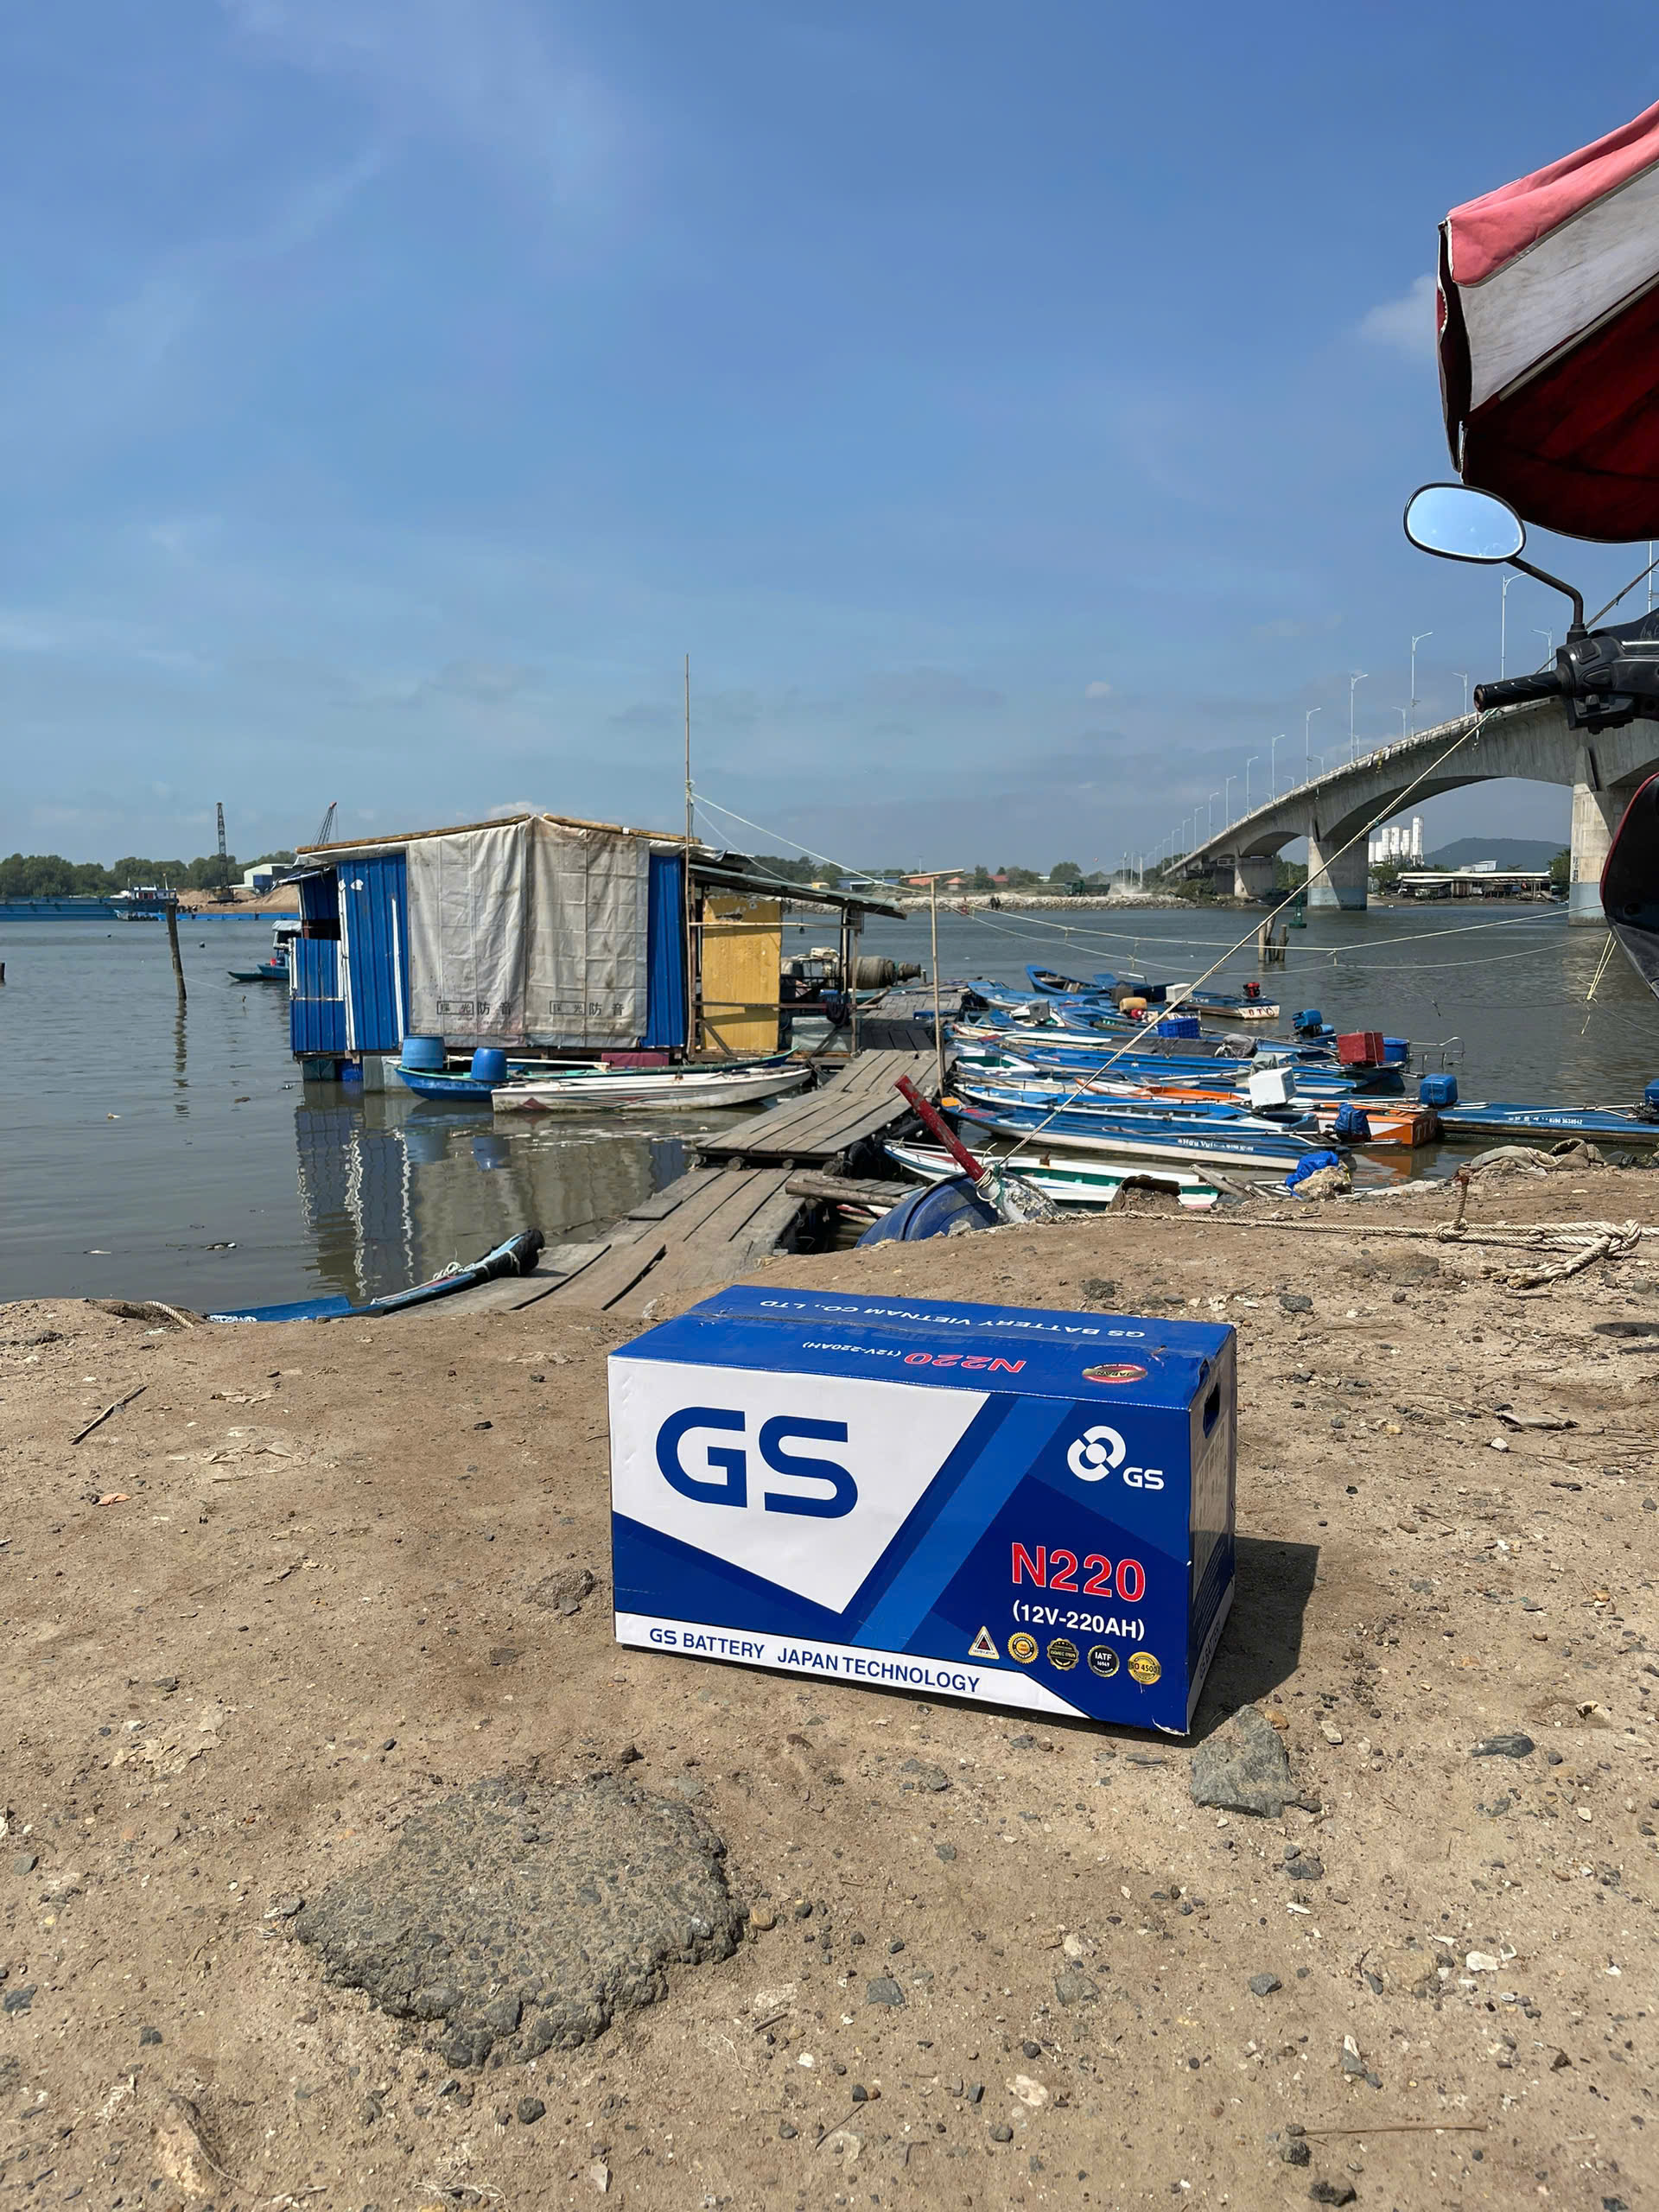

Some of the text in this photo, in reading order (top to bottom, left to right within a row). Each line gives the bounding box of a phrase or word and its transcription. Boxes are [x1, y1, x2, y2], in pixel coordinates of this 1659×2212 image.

[477, 1002, 512, 1016] 防音
[588, 1002, 625, 1016] 防音
[760, 1300, 807, 1309] LTD
[864, 1308, 970, 1325] VIETNAM
[978, 1320, 1101, 1336] BATTERY
[802, 1342, 1027, 1373] N220 (12V-220AH)
[655, 1406, 859, 1519] GS
[1123, 1467, 1165, 1491] GS
[1011, 1541, 1147, 1603] N220
[1012, 1599, 1146, 1642] (12V-220AH)
[649, 1628, 980, 1693] GS BATTERY JAPAN TECHNOLOGY
[1095, 1651, 1113, 1662] IATF
